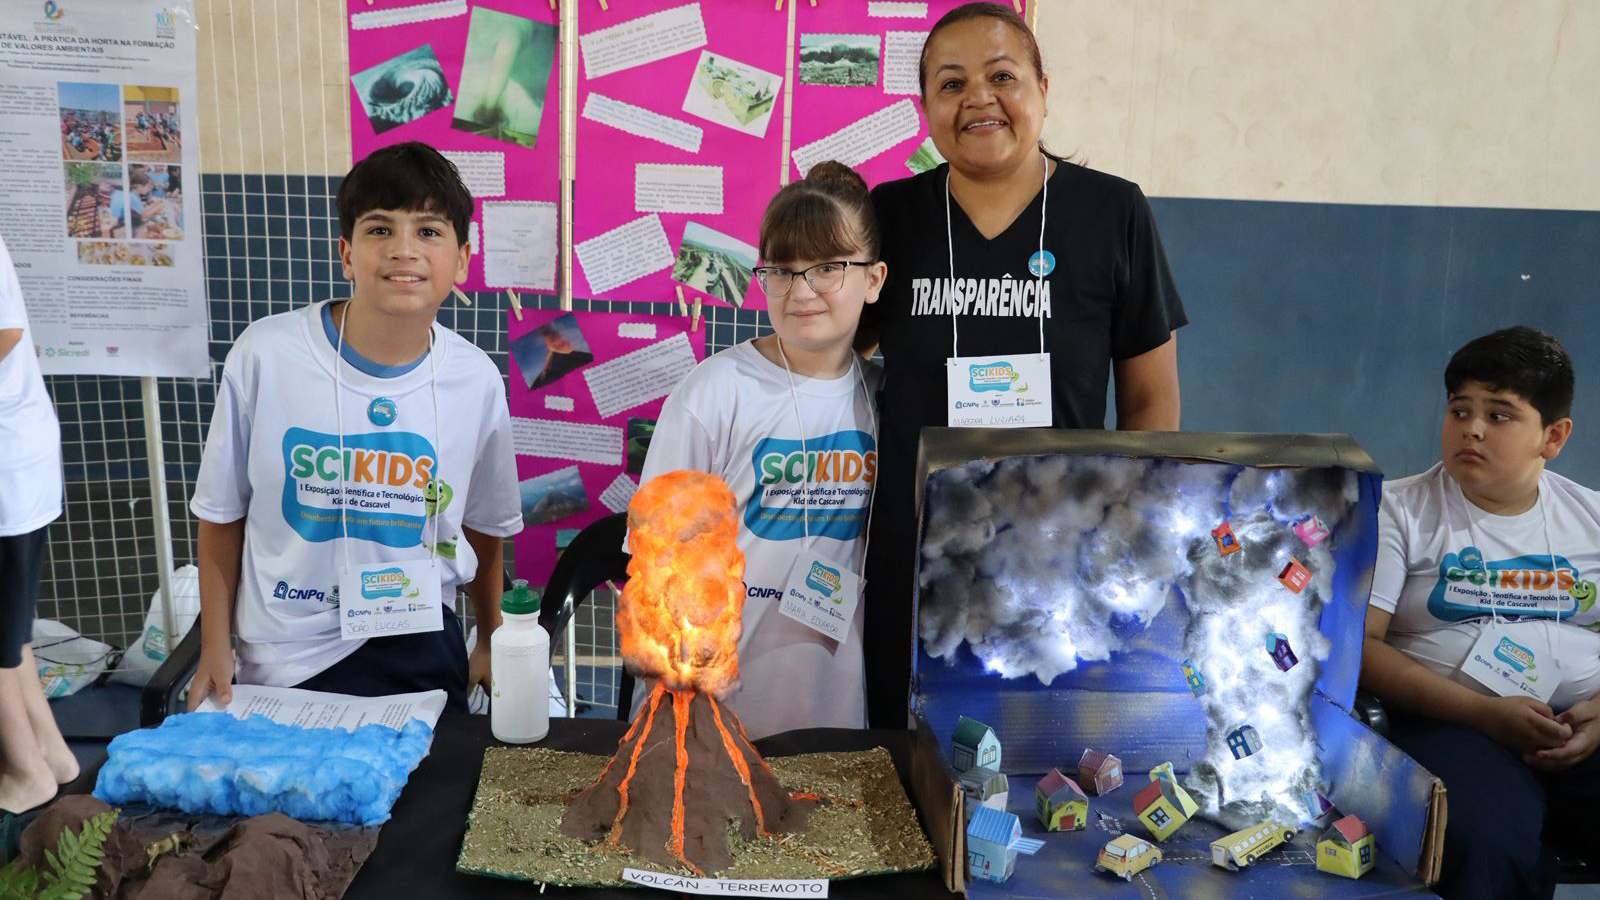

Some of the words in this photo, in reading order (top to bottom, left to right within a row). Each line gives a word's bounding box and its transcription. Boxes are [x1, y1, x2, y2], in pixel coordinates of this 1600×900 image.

[14, 42, 54, 51] VALORES
[55, 45, 105, 53] AMBIENTAIS
[91, 38, 119, 46] HORTA
[132, 40, 175, 49] FORMAÇÃO
[67, 275, 121, 283] CONSIDERAÇÕES
[911, 273, 1052, 319] TRANSPARÊNCIA
[57, 348, 90, 357] Sicredi
[973, 367, 1011, 377] SCIKIDS
[293, 446, 433, 489] SCIKIDS
[761, 451, 877, 484] SCIKIDS
[305, 483, 340, 496] Exposição
[382, 490, 424, 503] Tecnológica
[770, 488, 801, 497] Exposição
[349, 498, 359, 506] de
[360, 500, 391, 509] Cascavel
[818, 497, 846, 505] Cascavel
[364, 573, 403, 584] SCIKIDS
[288, 587, 325, 602] CNPq
[747, 586, 783, 601] CNPq
[1453, 587, 1488, 597] Exposição
[1507, 600, 1538, 608] Cascavel
[630, 871, 699, 890] VOLCÁN
[717, 882, 823, 894] TERREMOTO
